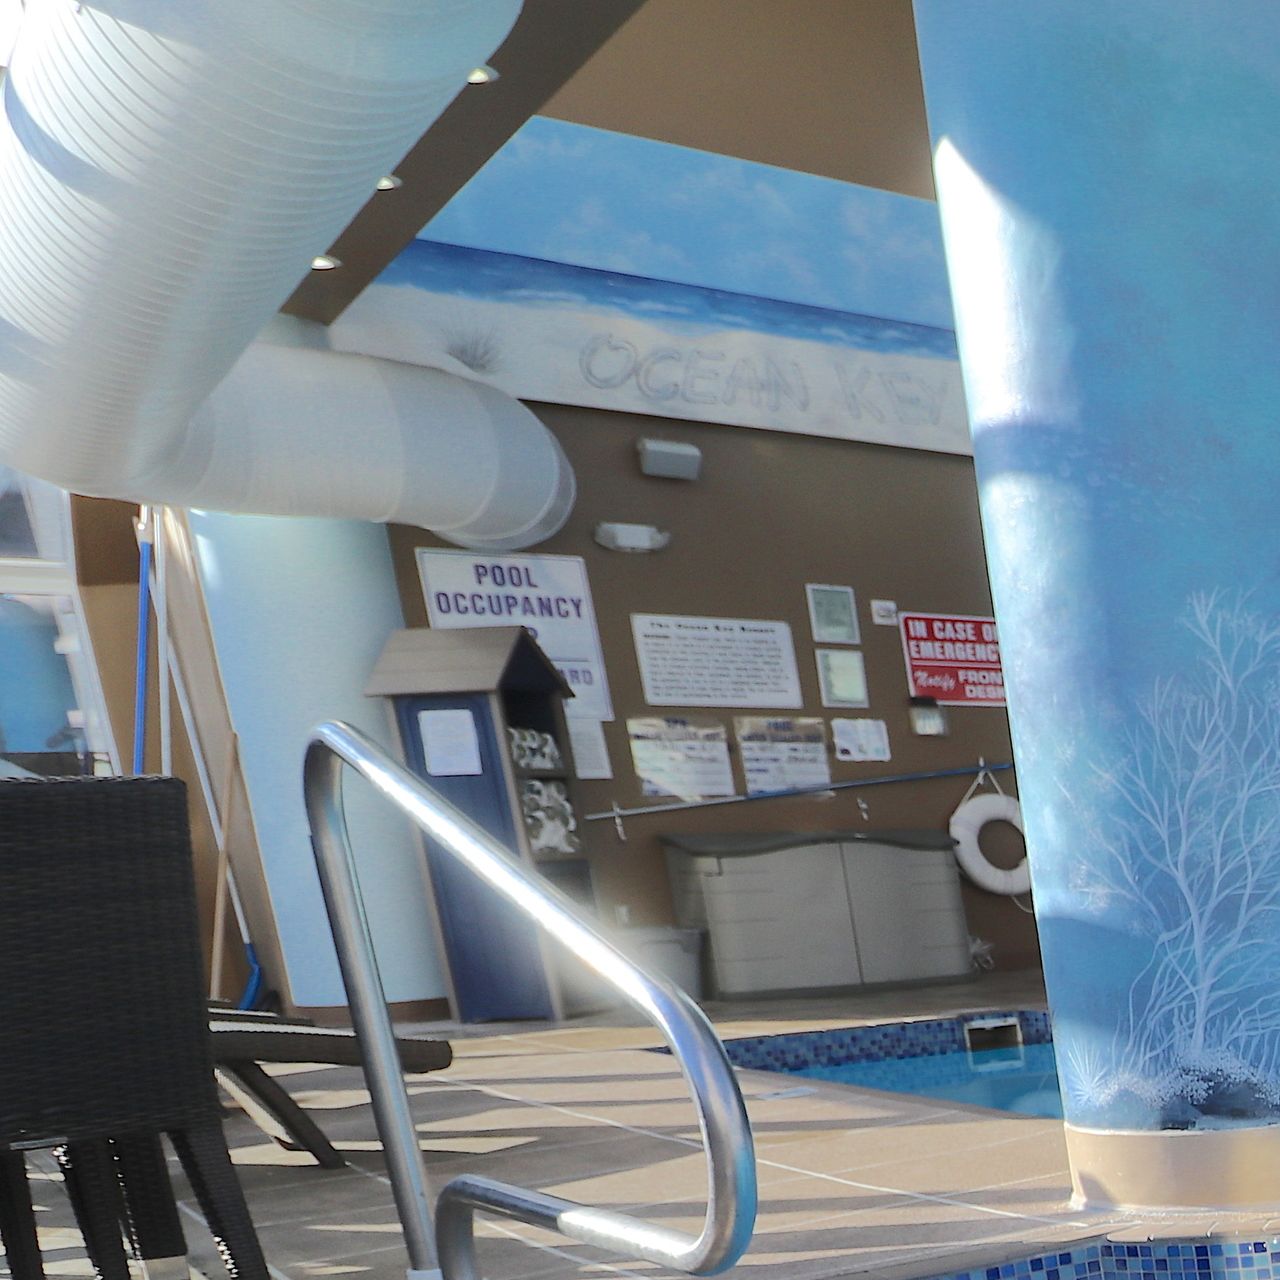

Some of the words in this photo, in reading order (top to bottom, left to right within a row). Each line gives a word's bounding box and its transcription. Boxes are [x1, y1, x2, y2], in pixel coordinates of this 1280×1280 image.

[579, 332, 810, 413] OCEAN
[474, 564, 538, 588] POOL
[436, 592, 582, 619] OCCUPANCY
[908, 620, 927, 638] IN
[932, 621, 976, 641] CASE
[909, 640, 998, 662] EMERGENC
[958, 670, 1002, 685] FRON
